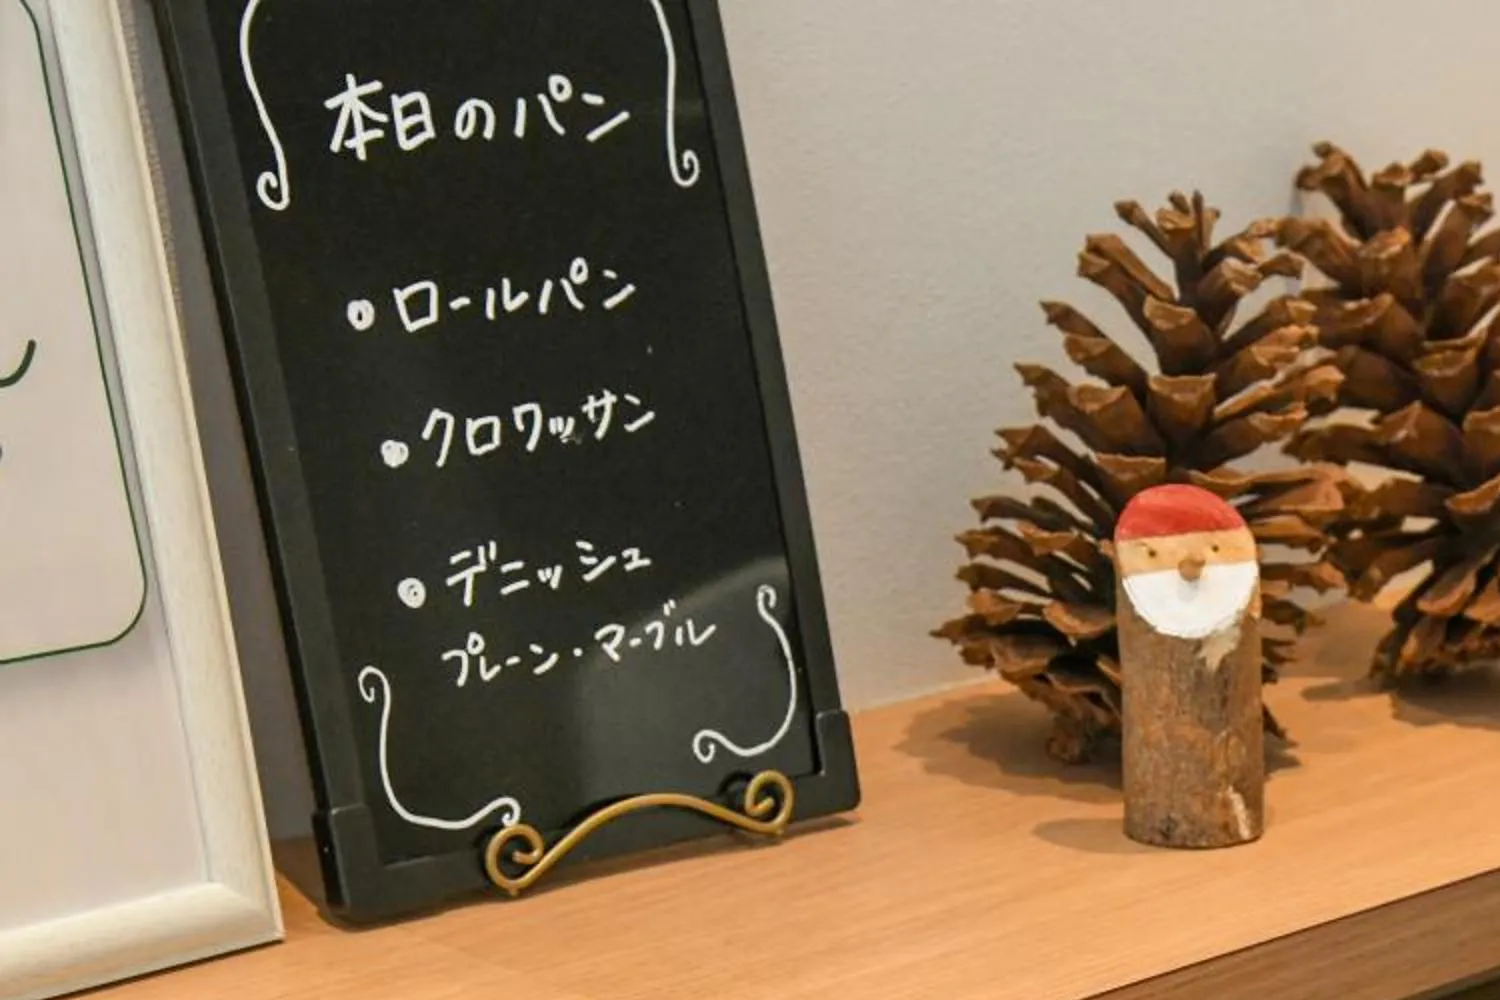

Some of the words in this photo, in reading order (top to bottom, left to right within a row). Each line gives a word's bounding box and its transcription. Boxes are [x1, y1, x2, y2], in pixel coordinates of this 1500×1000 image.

[325, 74, 629, 160] 本日のパン
[394, 258, 634, 332] ロールパン
[422, 390, 654, 466] クロワッサン
[447, 541, 650, 606] デニッシュ
